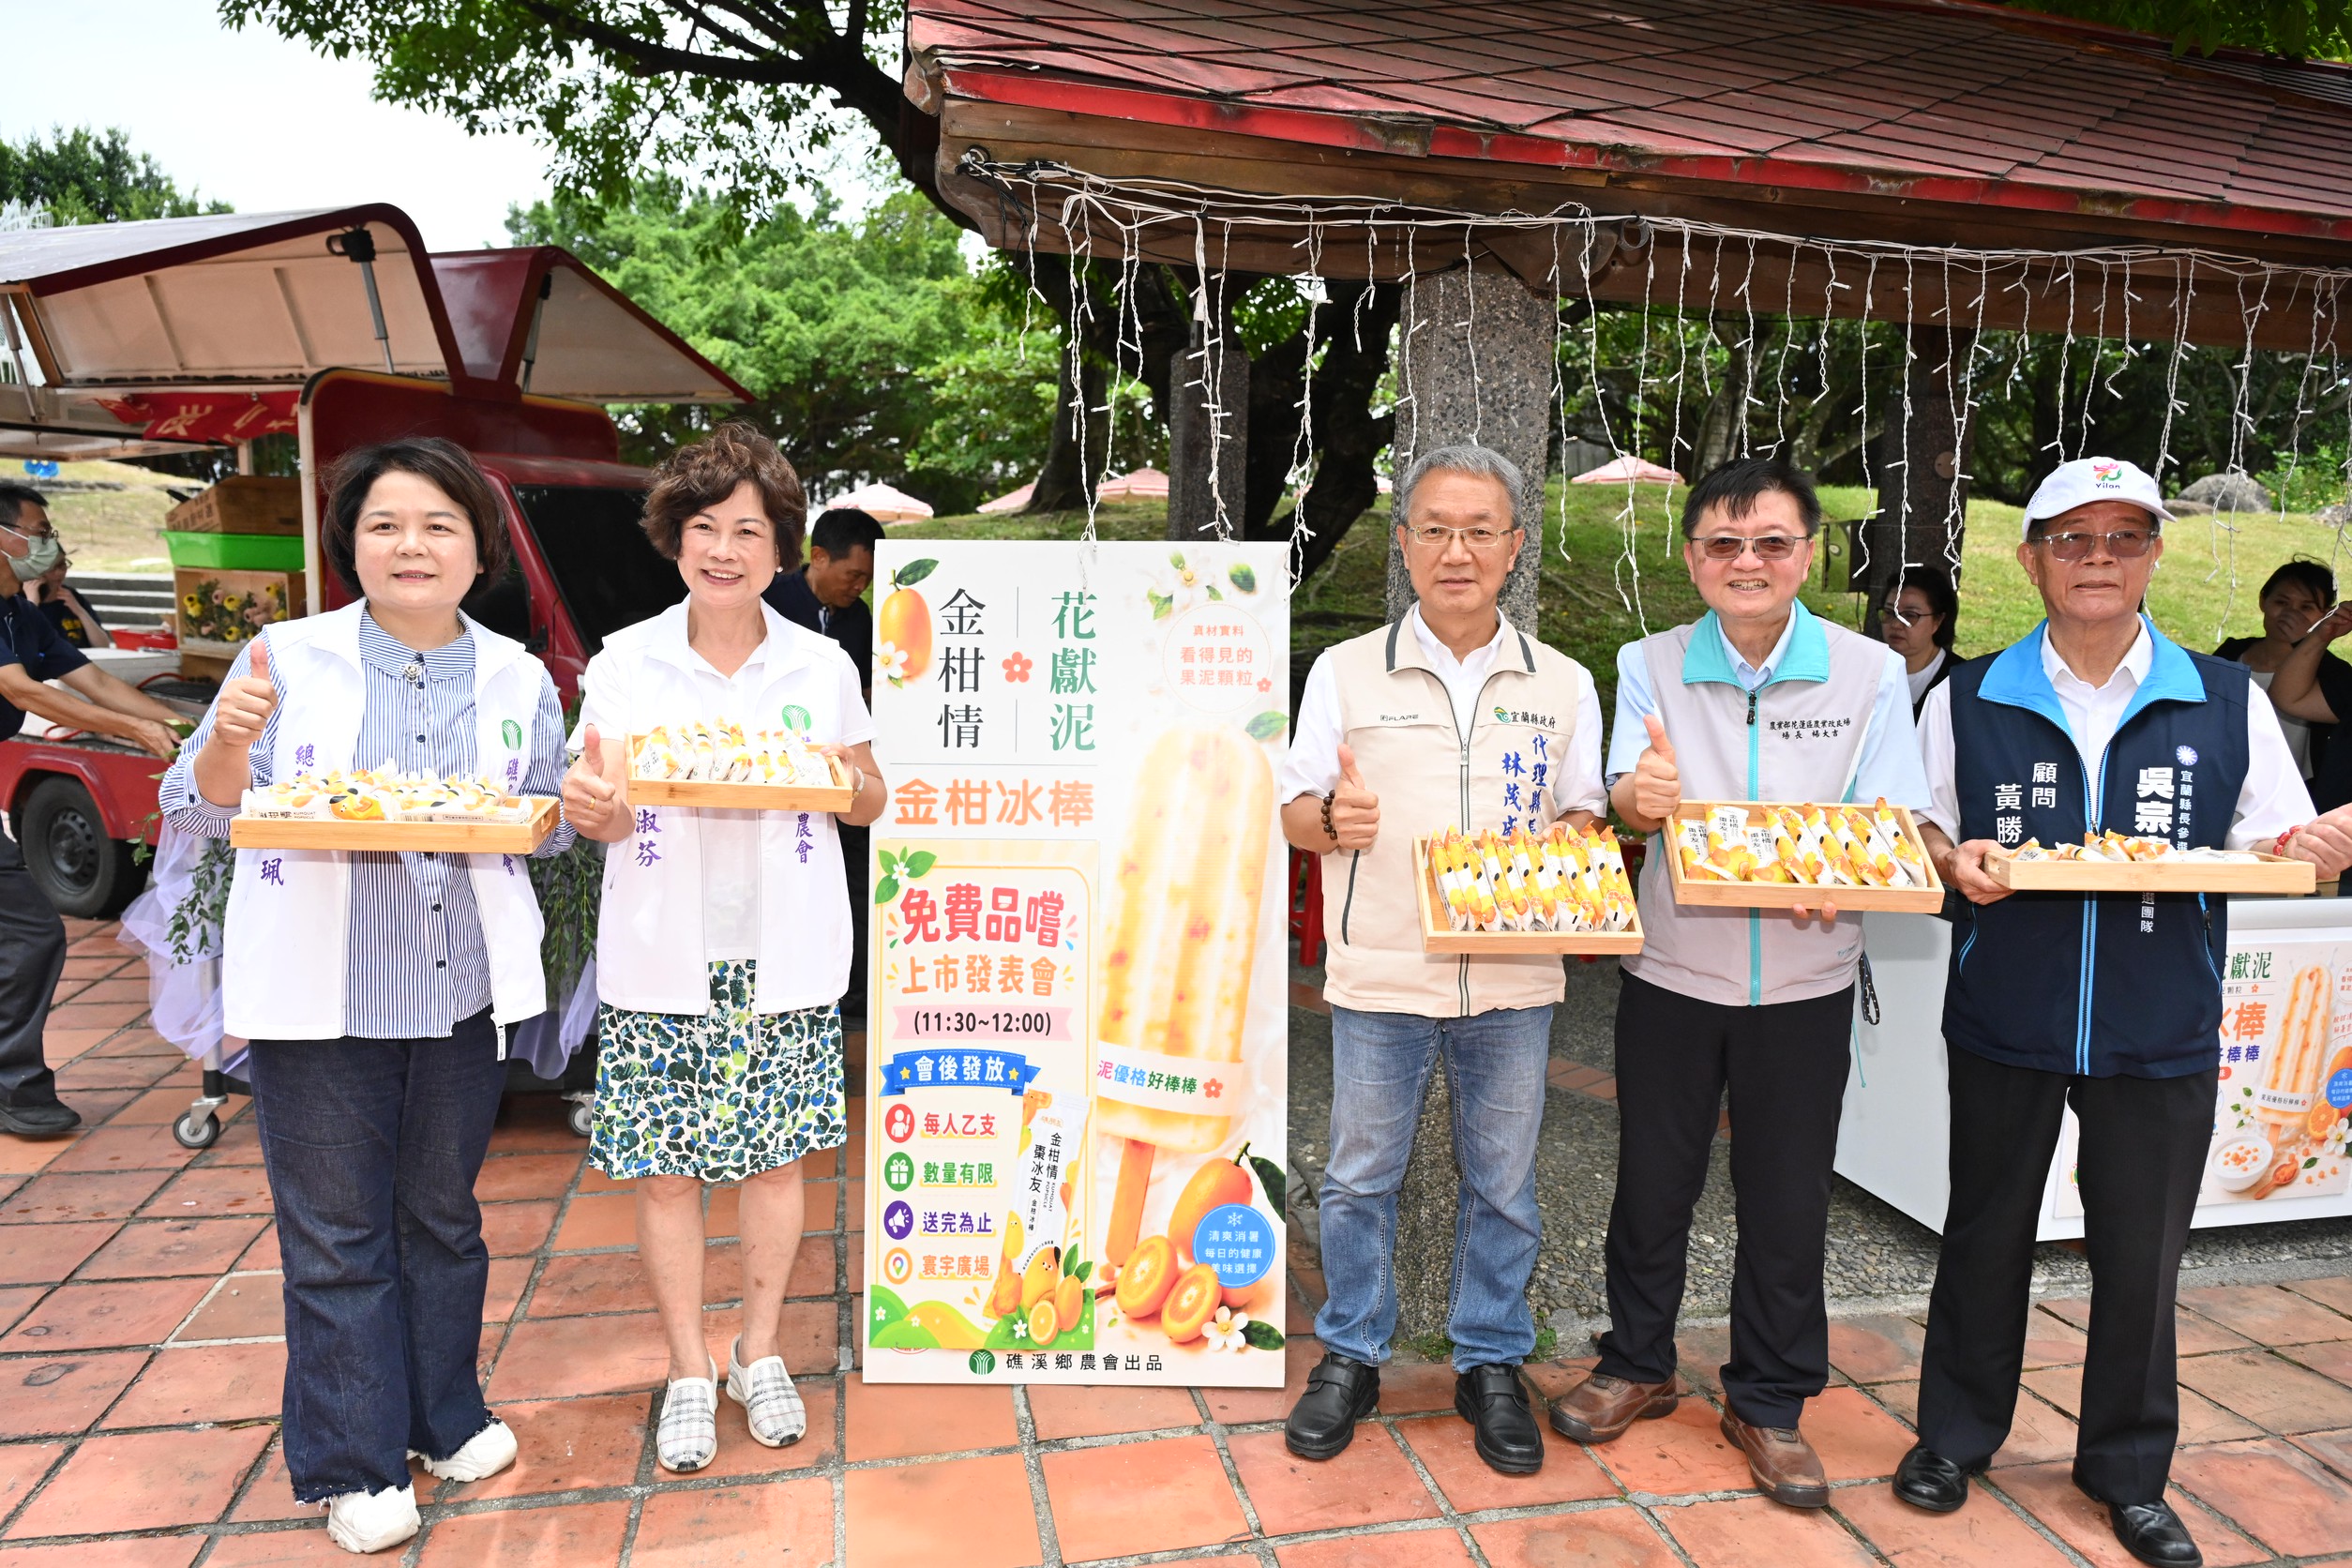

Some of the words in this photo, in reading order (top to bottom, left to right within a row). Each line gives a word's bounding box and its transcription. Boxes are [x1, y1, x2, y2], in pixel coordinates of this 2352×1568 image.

[1193, 625, 1244, 637] 真材實料
[937, 587, 987, 748] 金柑情
[1180, 646, 1253, 663] 看得見的
[1049, 591, 1098, 751] 花獻泥
[1180, 670, 1253, 686] 果泥顆粒
[1510, 711, 1556, 729] 宜蘭縣政府
[295, 744, 315, 776] 總
[1529, 734, 1548, 836] 代理縣長
[2031, 761, 2058, 808] 顧問
[894, 777, 1094, 827] 金柑冰棒
[1995, 783, 2023, 844] 黃勝
[2134, 767, 2175, 844] 吳宗
[635, 809, 662, 867] 淑芬
[795, 813, 814, 865] 農會
[900, 882, 1064, 948] 免費品嚐
[901, 954, 1057, 997] 上市發表會
[2223, 952, 2272, 980] 獻泥
[914, 1011, 1051, 1036] (11:30~12:00)
[914, 1055, 1005, 1082] 會後發放
[1096, 1060, 1198, 1094] 泥優格好棒棒
[924, 1112, 996, 1136] 每人乙支
[1046, 1132, 1062, 1180] 金柑情
[923, 1162, 993, 1184] 數量有限
[923, 1212, 992, 1233] 送完為止
[1208, 1230, 1259, 1243] 清爽消暑
[922, 1255, 989, 1276] 寰宇廣場
[1204, 1247, 1262, 1259] 每日的健康
[1212, 1263, 1257, 1274] 美味選擇
[1005, 1352, 1163, 1372] 礁溪鄉農會出品
